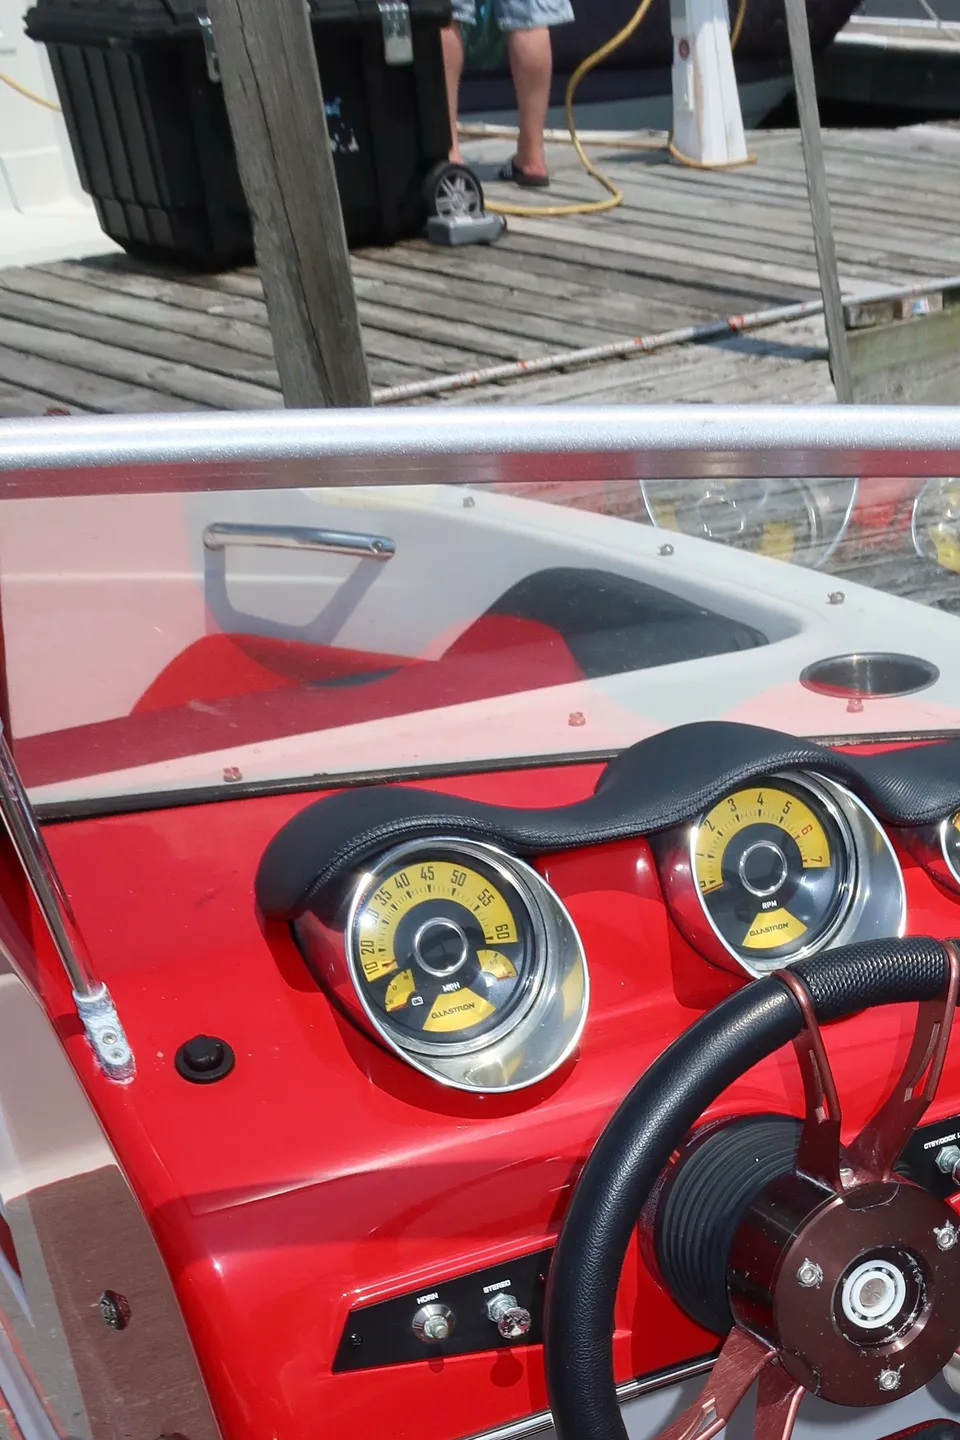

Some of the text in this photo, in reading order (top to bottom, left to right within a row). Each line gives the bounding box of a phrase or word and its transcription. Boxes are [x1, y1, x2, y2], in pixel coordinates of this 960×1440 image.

[727, 798, 737, 812] 3
[757, 792, 764, 805] 4
[782, 800, 792, 814] 5
[704, 819, 715, 832] 2
[801, 824, 813, 835] 6
[420, 866, 435, 880] 45
[451, 869, 467, 887] 50
[394, 872, 411, 889] 40
[374, 886, 392, 906] 35
[477, 888, 495, 907] 55
[761, 900, 778, 910] RPM
[495, 923, 510, 939] 60
[749, 922, 789, 937] GLASTRON
[360, 940, 375, 956] 20
[364, 961, 380, 975] 10
[442, 981, 461, 992] MPH
[431, 1002, 476, 1019] GLASTRON
[483, 1279, 511, 1293] STEREO
[416, 1292, 439, 1304] HORN
